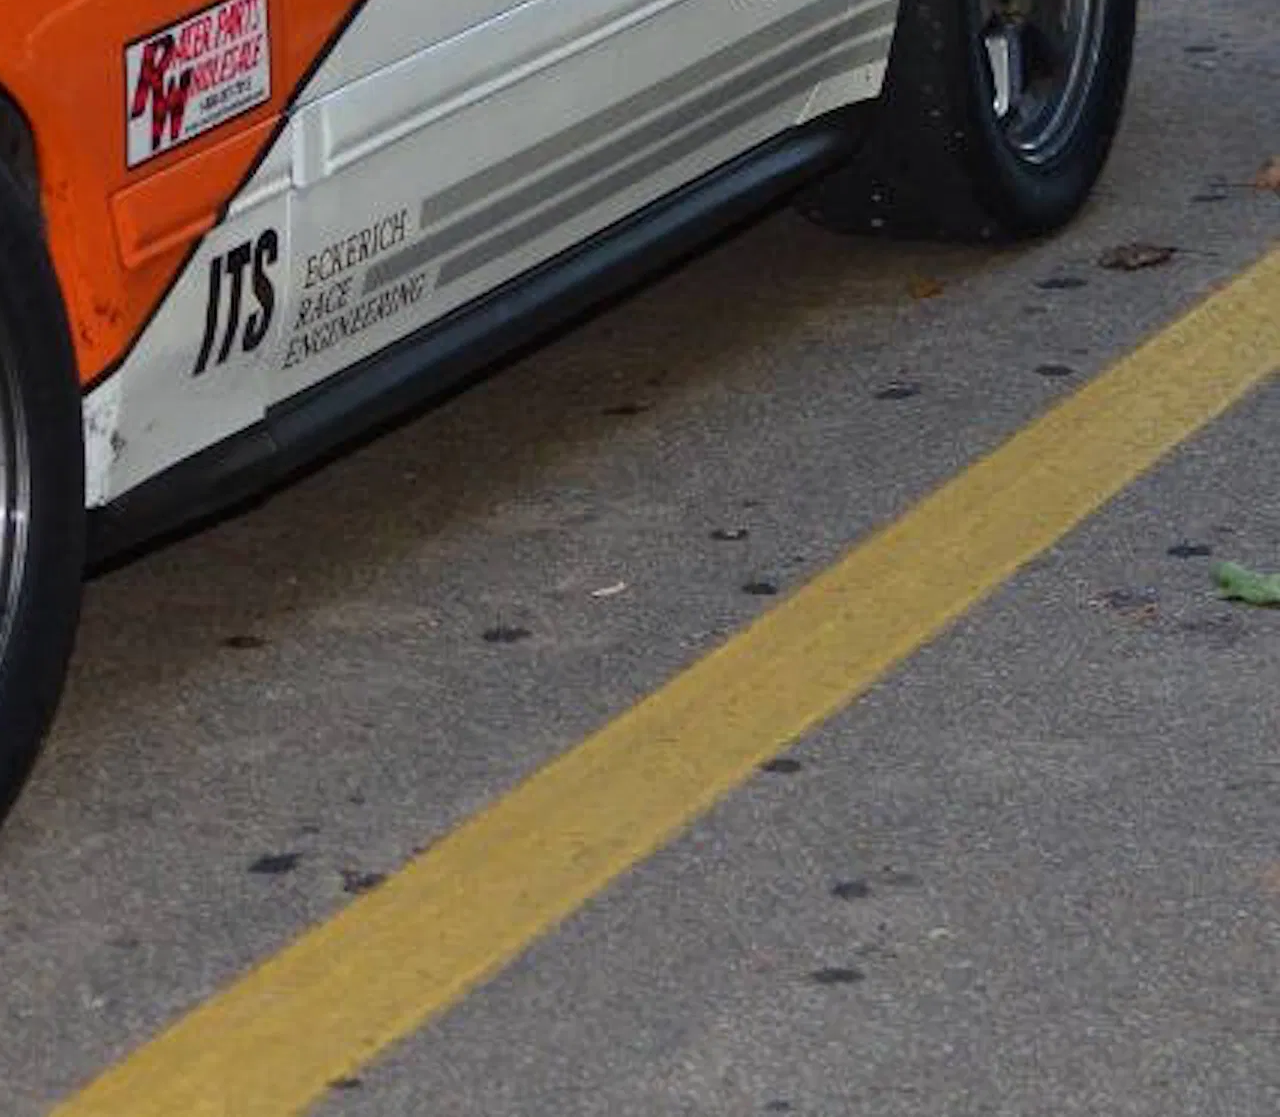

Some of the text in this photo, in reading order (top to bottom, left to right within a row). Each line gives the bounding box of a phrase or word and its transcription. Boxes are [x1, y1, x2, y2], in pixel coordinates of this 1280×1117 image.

[302, 208, 409, 289] ECKERICH
[191, 228, 279, 377] ITS
[280, 271, 427, 370] ENGINEERING
[293, 275, 354, 330] RACE
